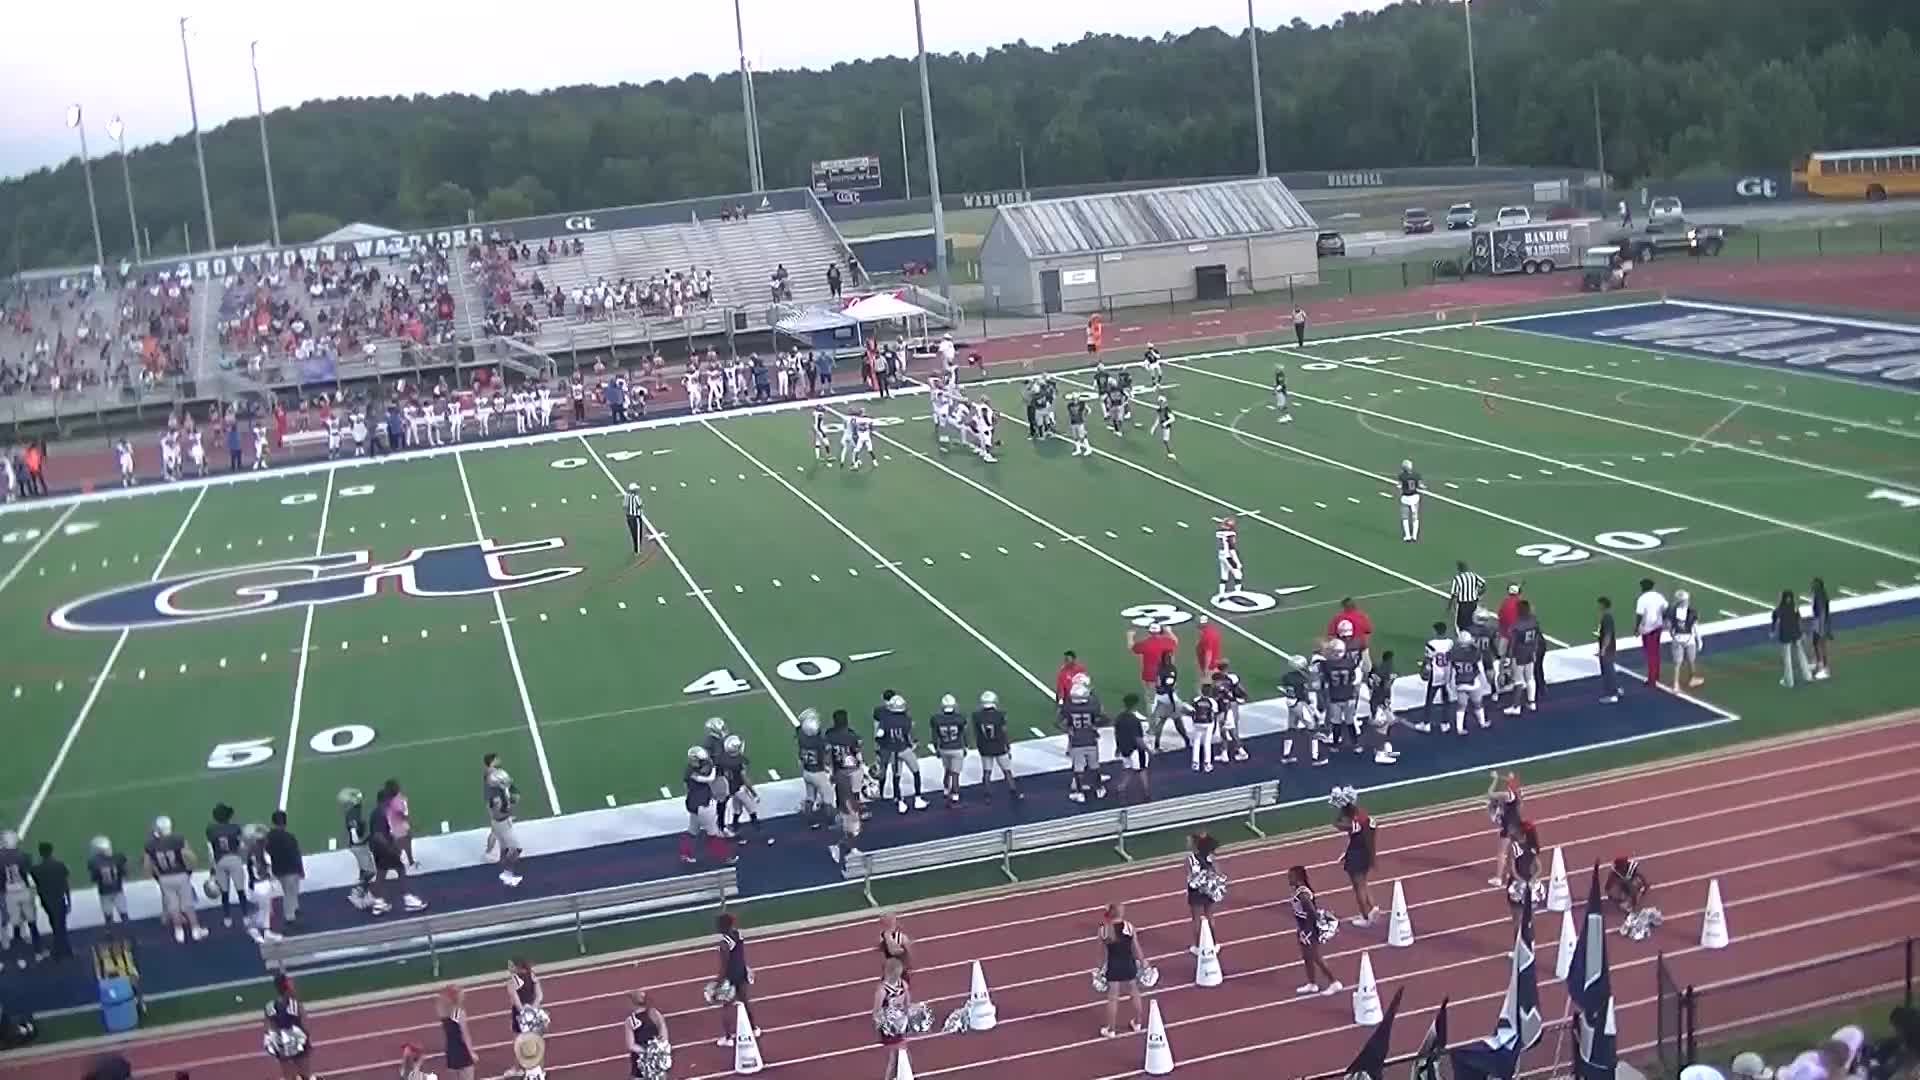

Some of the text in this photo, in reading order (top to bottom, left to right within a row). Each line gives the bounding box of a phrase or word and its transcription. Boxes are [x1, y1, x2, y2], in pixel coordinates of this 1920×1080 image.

[1735, 176, 1777, 198] Gt
[565, 215, 597, 231] Gt
[48, 536, 584, 632] Gt
